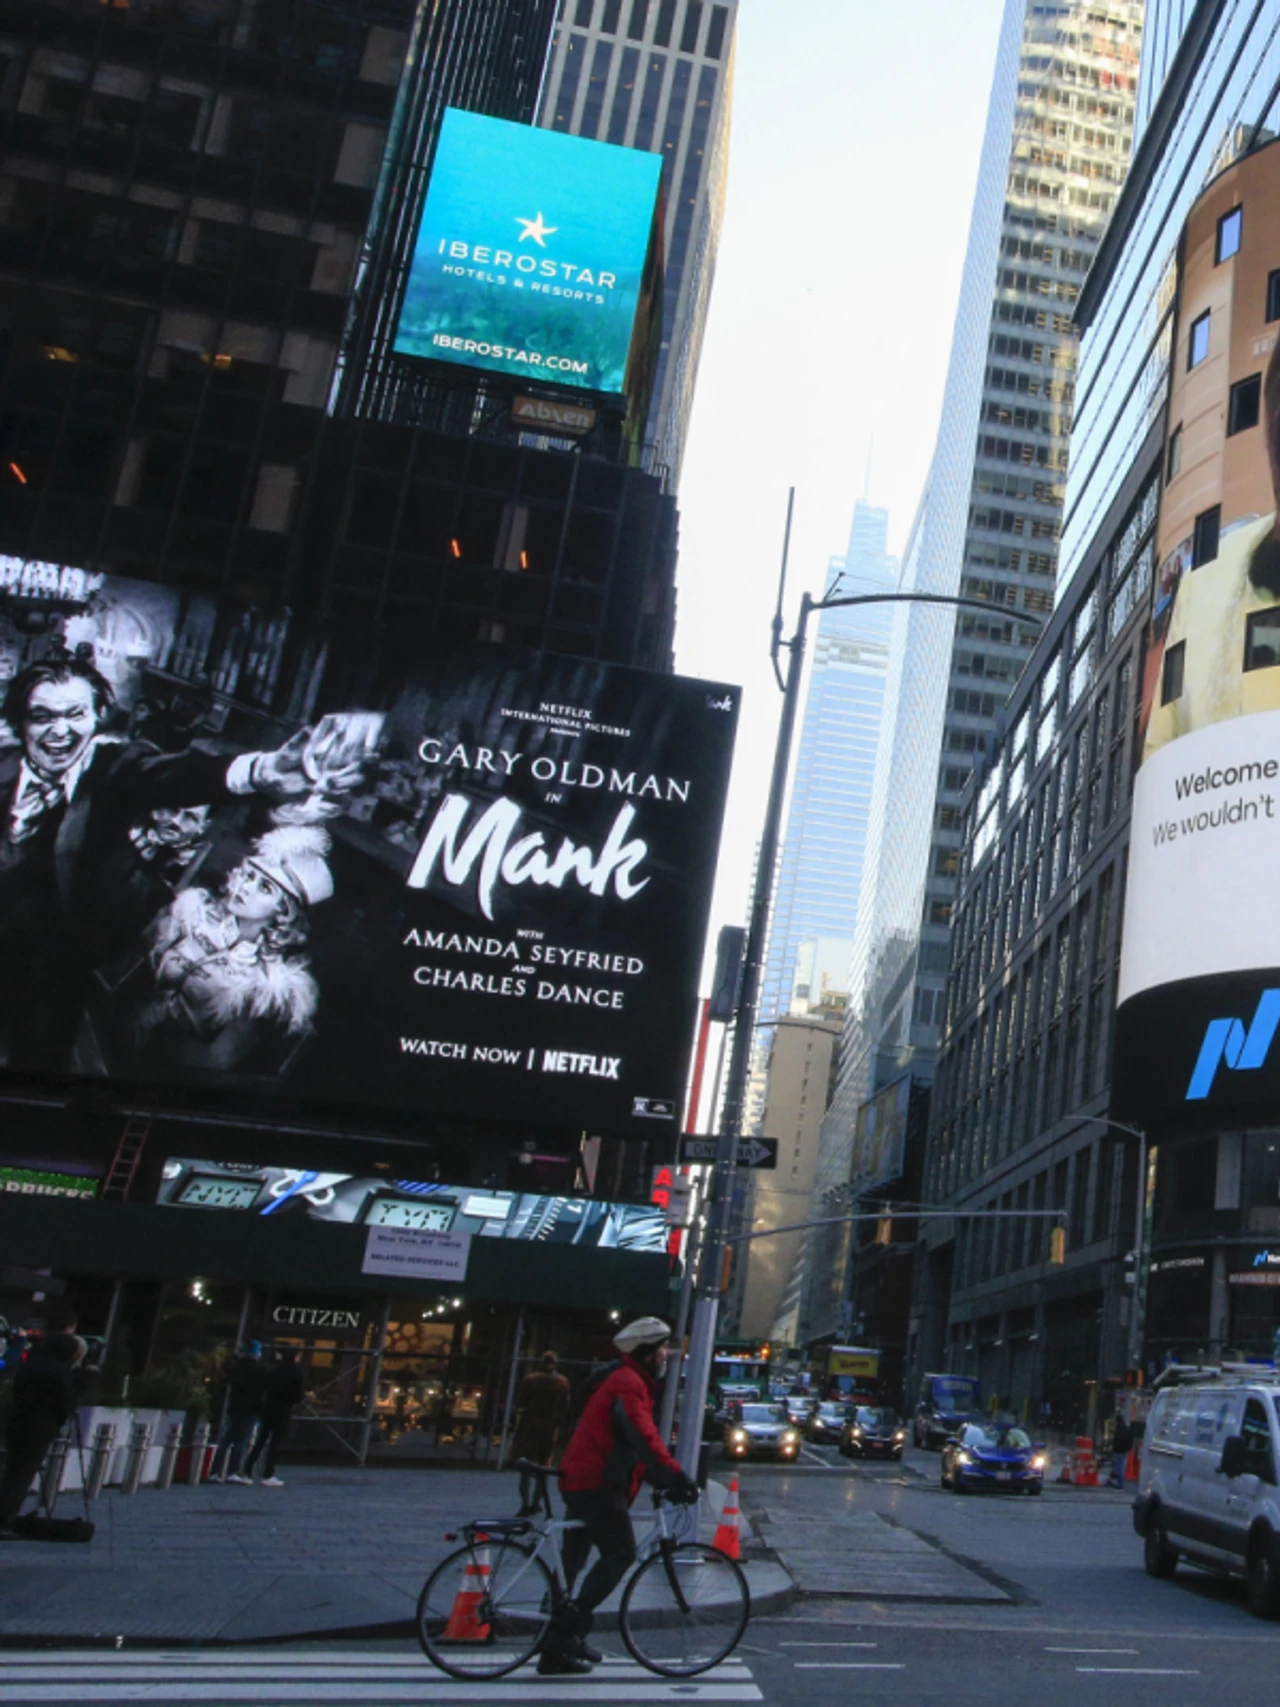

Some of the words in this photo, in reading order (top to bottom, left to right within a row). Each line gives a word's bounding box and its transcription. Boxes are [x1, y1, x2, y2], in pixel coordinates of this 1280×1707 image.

[438, 238, 617, 289] IBEROSTAR
[442, 264, 507, 286] HOTELS
[513, 277, 524, 288] &
[531, 282, 605, 305] RESORTS
[433, 333, 589, 375] IBEROSTAR.COM
[501, 708, 581, 729] INTERNATIONAL
[584, 722, 631, 737] PICTURES
[540, 702, 593, 720] NETFLIX
[418, 738, 524, 776] GARY
[531, 757, 692, 803] OLDMAN
[1174, 753, 1278, 800] Welcome
[545, 792, 562, 804] IN
[1153, 821, 1178, 848] We
[406, 793, 652, 921] Mank
[403, 927, 521, 960] AMANDA
[529, 944, 645, 975] SEYFRIED
[516, 928, 545, 941] WITH
[413, 966, 527, 997] CHARLES
[537, 981, 625, 1010] DANCE
[512, 963, 537, 976] AND
[400, 1037, 467, 1060] WATCH
[473, 1047, 522, 1065] NOW
[542, 1050, 621, 1081] NETFLIX
[272, 1304, 361, 1329] CITIZEN
